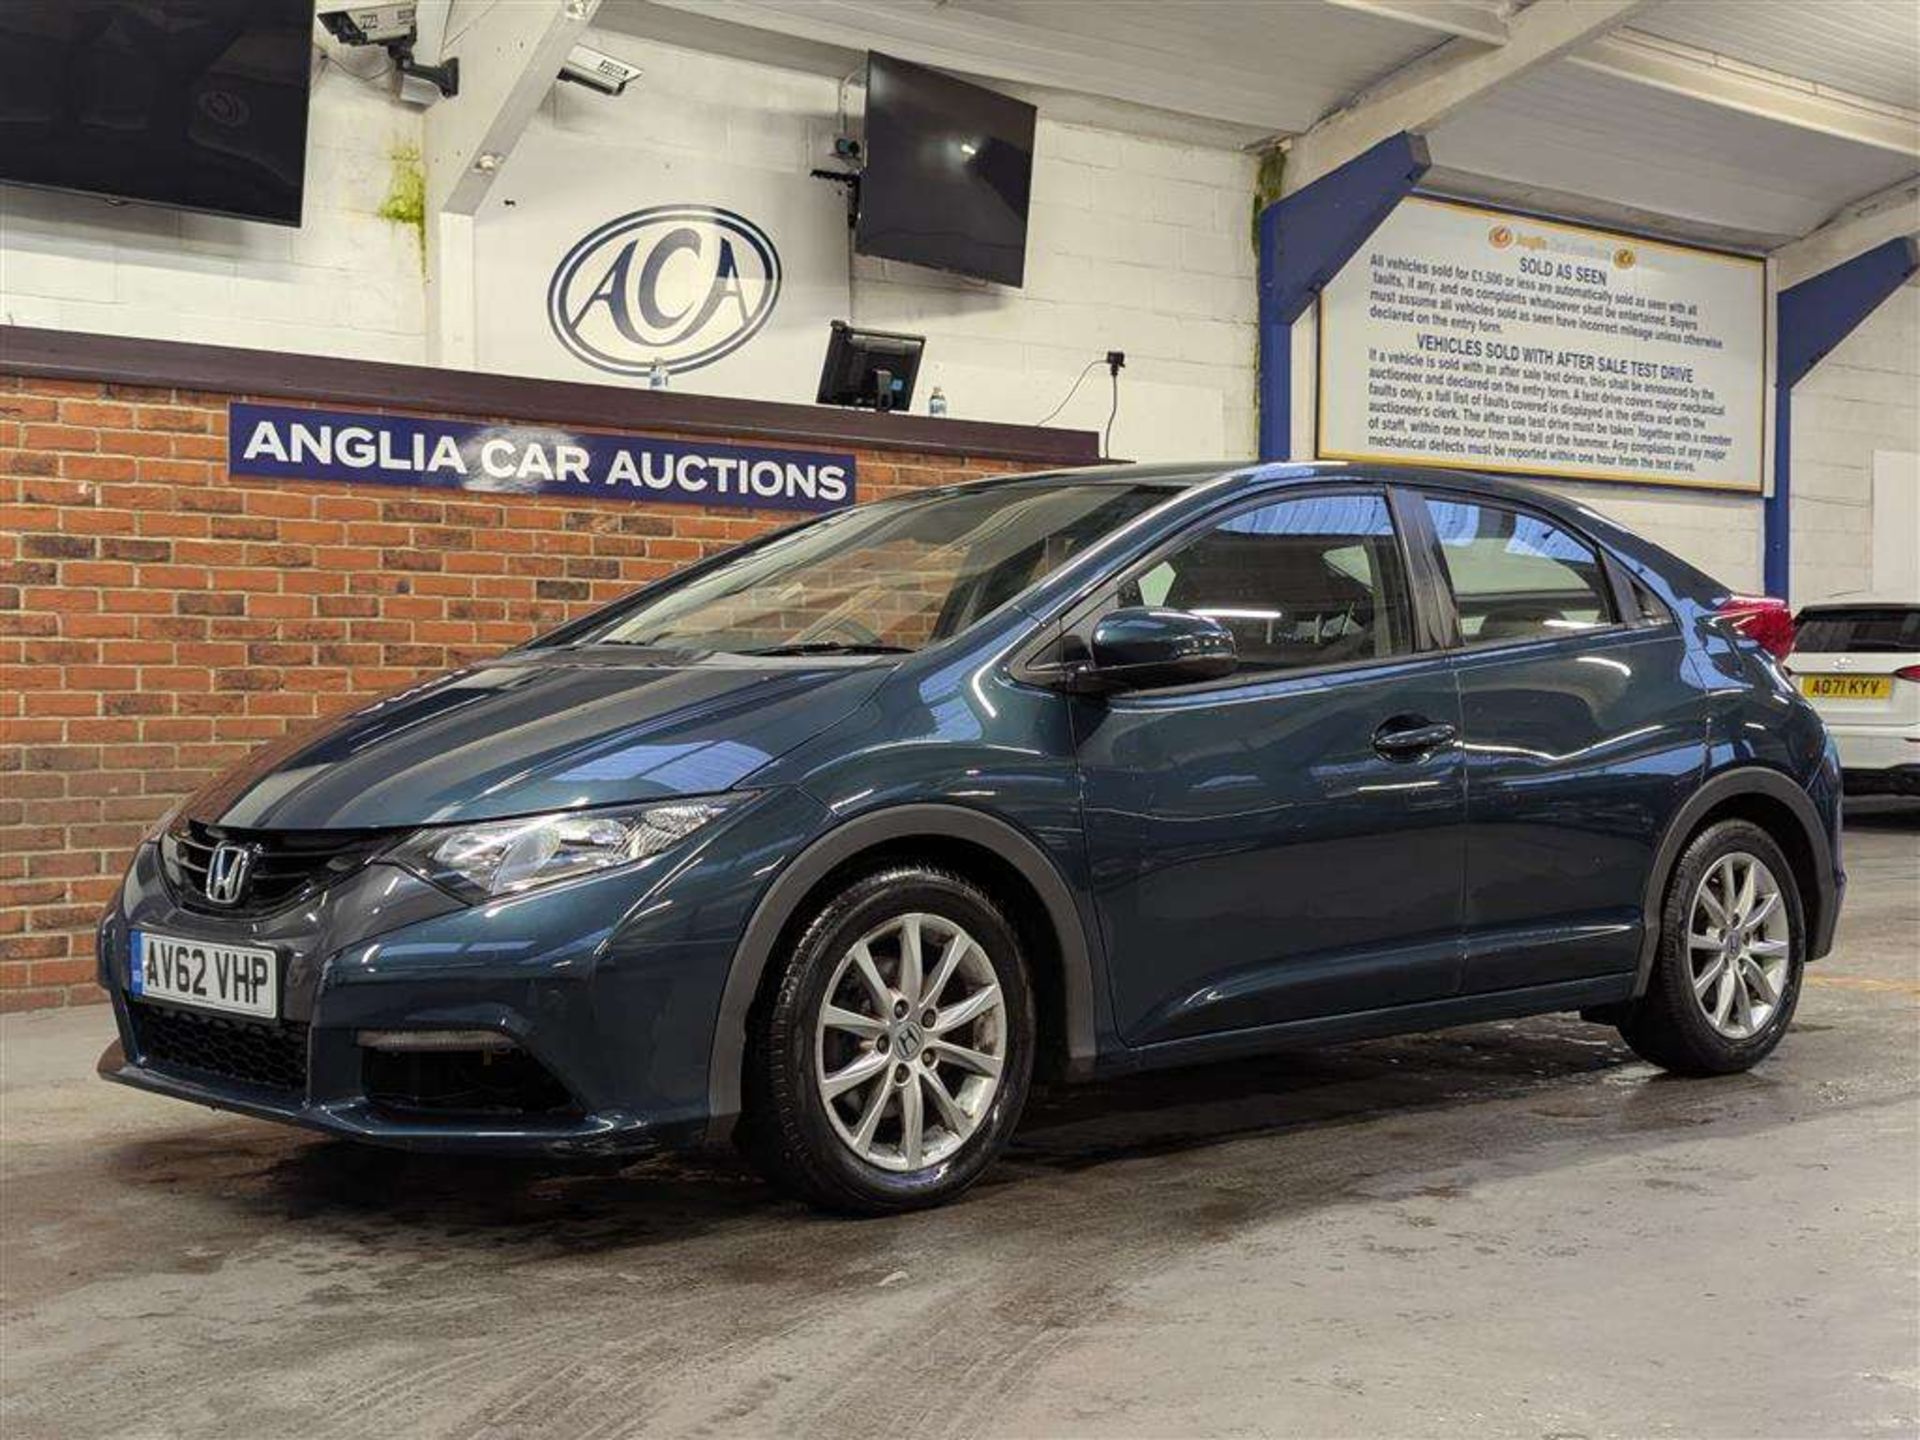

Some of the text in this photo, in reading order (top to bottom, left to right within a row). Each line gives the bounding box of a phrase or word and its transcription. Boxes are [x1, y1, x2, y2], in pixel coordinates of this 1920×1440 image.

[568, 228, 751, 347] ACA
[1370, 253, 1384, 268] All
[1387, 257, 1428, 274] vehicles
[1431, 264, 1452, 278] sold
[1455, 266, 1469, 280] for
[1505, 276, 1514, 287] or
[1516, 275, 1535, 290] less
[1538, 281, 1553, 292] are
[1555, 284, 1613, 304] automatically
[1615, 292, 1634, 306] sold
[1635, 296, 1645, 307] as
[1648, 299, 1667, 311] seen
[1669, 300, 1686, 314] with
[1519, 257, 1608, 286] SOLD AS SEEN
[1370, 290, 1396, 304] must
[1398, 295, 1438, 309] assume
[1440, 297, 1452, 310] all
[1455, 300, 1495, 317] vehicles
[1497, 306, 1517, 320] sold
[1518, 311, 1530, 321] as
[1533, 313, 1553, 325] seen
[1556, 315, 1578, 329] have
[1579, 318, 1618, 334] incorrect
[1620, 326, 1653, 342] mileage
[1370, 306, 1415, 323] declared
[1416, 313, 1430, 325] on
[1432, 314, 1448, 328] the
[1450, 319, 1476, 333] entry
[1407, 277, 1415, 288] if
[1439, 282, 1458, 295] and
[1460, 287, 1474, 298] no
[1476, 288, 1527, 305] complaints
[1583, 303, 1603, 317] shall
[1605, 306, 1617, 319] be
[1379, 352, 1385, 362] a
[1388, 352, 1424, 367] vehicle
[1426, 356, 1436, 368] is
[1438, 358, 1460, 370] sold
[1462, 362, 1483, 373] with
[1485, 364, 1497, 375] an
[1498, 365, 1520, 377] after
[1522, 368, 1542, 380] sale
[1543, 371, 1561, 383] test
[1589, 376, 1607, 388] this
[1608, 378, 1630, 390] shall
[1631, 381, 1643, 392] be
[1644, 384, 1688, 398] announced
[1690, 388, 1700, 400] by
[1701, 389, 1715, 400] the
[1416, 333, 1694, 383] VEHICLES SOLD WITH AFTER SALE TEST DRIVE
[1369, 367, 1423, 384] auctioneer
[1424, 373, 1445, 386] and
[1445, 375, 1490, 391] declared
[1491, 381, 1503, 391] on
[1505, 382, 1520, 394] the
[1522, 386, 1546, 400] entry
[1573, 389, 1579, 399] A
[1582, 390, 1599, 402] test
[1601, 392, 1623, 405] drive
[1625, 396, 1653, 408] covers
[1655, 399, 1679, 413] major
[1680, 401, 1726, 416] mechanical
[1369, 382, 1398, 398] faults
[1426, 391, 1433, 401] a
[1434, 390, 1452, 402] full
[1453, 391, 1469, 404] list
[1471, 394, 1483, 406] of
[1483, 394, 1510, 409] faults
[1511, 398, 1548, 413] covered
[1549, 402, 1559, 414] is
[1560, 403, 1604, 419] displayed
[1604, 408, 1614, 419] in
[1615, 409, 1630, 421] the
[1631, 411, 1656, 424] office
[1657, 414, 1673, 426] and
[1674, 415, 1693, 427] with
[1693, 417, 1706, 428] the
[1368, 418, 1380, 430] of
[1410, 422, 1441, 435] within
[1443, 425, 1461, 436] one
[1463, 426, 1487, 438] hour
[1488, 428, 1510, 441] from
[1512, 431, 1527, 442] the
[1545, 434, 1556, 446] of
[1556, 435, 1571, 447] the
[1612, 439, 1628, 454] Any
[1631, 441, 1676, 456] complaints
[1678, 446, 1688, 456] of
[1689, 448, 1702, 460] any
[1704, 449, 1726, 462] major
[1464, 409, 1481, 422] The
[1483, 412, 1505, 425] after
[1507, 414, 1526, 426] sale
[1528, 416, 1546, 428] test
[1547, 418, 1570, 430] drive
[1573, 421, 1595, 433] must
[1596, 423, 1608, 434] be
[1638, 428, 1673, 441] together
[1674, 430, 1692, 442] with
[1700, 434, 1732, 446] member
[243, 421, 847, 501] ANGLIA CAR AUCTIONS
[1368, 434, 1426, 450] mechanical
[1429, 439, 1465, 453] defects
[1468, 444, 1492, 455] must
[1494, 445, 1505, 457] be
[1507, 447, 1547, 461] reported
[1550, 450, 1577, 462] within
[1578, 453, 1595, 463] one
[1596, 453, 1617, 465] hour
[1619, 454, 1639, 467] from
[1640, 457, 1654, 468] the
[1655, 458, 1672, 470] test
[1848, 680, 1879, 694] KYV
[147, 941, 268, 1004] AV62 VHP
